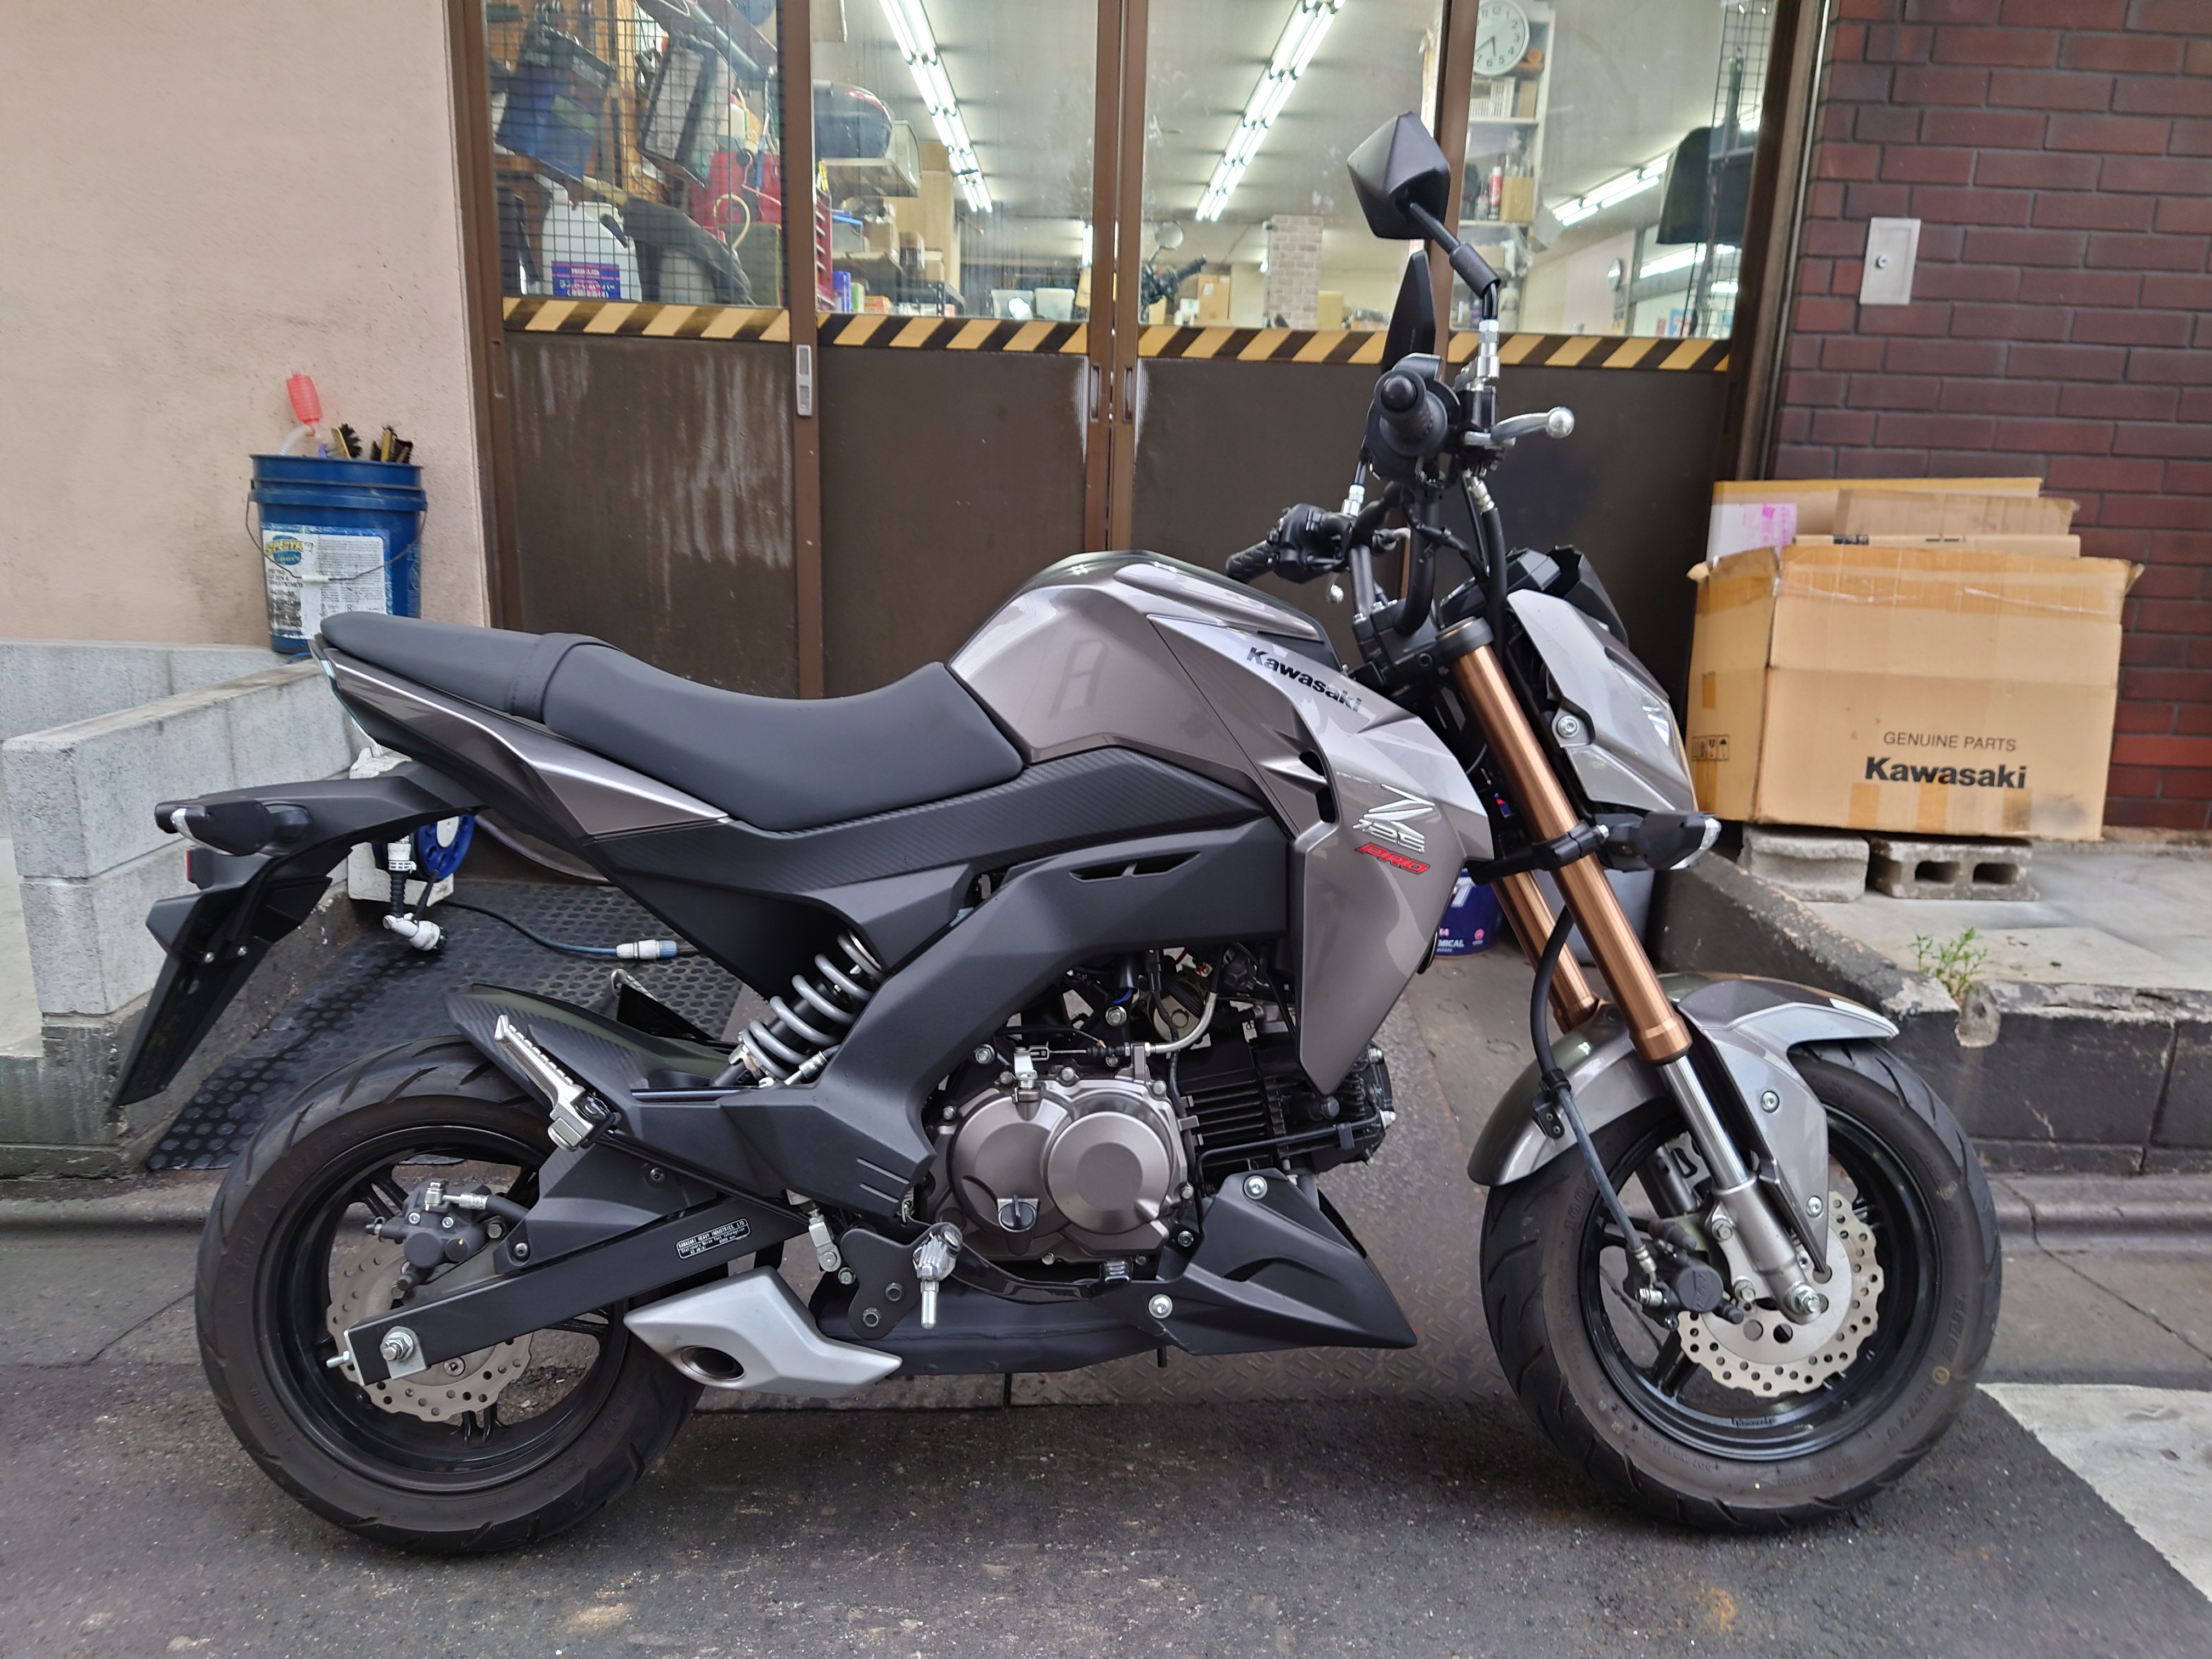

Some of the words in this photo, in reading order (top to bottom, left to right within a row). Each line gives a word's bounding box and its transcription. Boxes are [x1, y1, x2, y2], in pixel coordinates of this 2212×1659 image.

[1508, 46, 1514, 55] 4
[1246, 646, 1362, 713] Kawasaki
[1883, 731, 1959, 748] GENUINE
[1963, 736, 2017, 752] PARTS
[1865, 756, 2027, 789] Kawasaki
[1352, 819, 1425, 854] 125
[1355, 842, 1430, 875] PRO
[1437, 939, 1464, 948] MICAL
